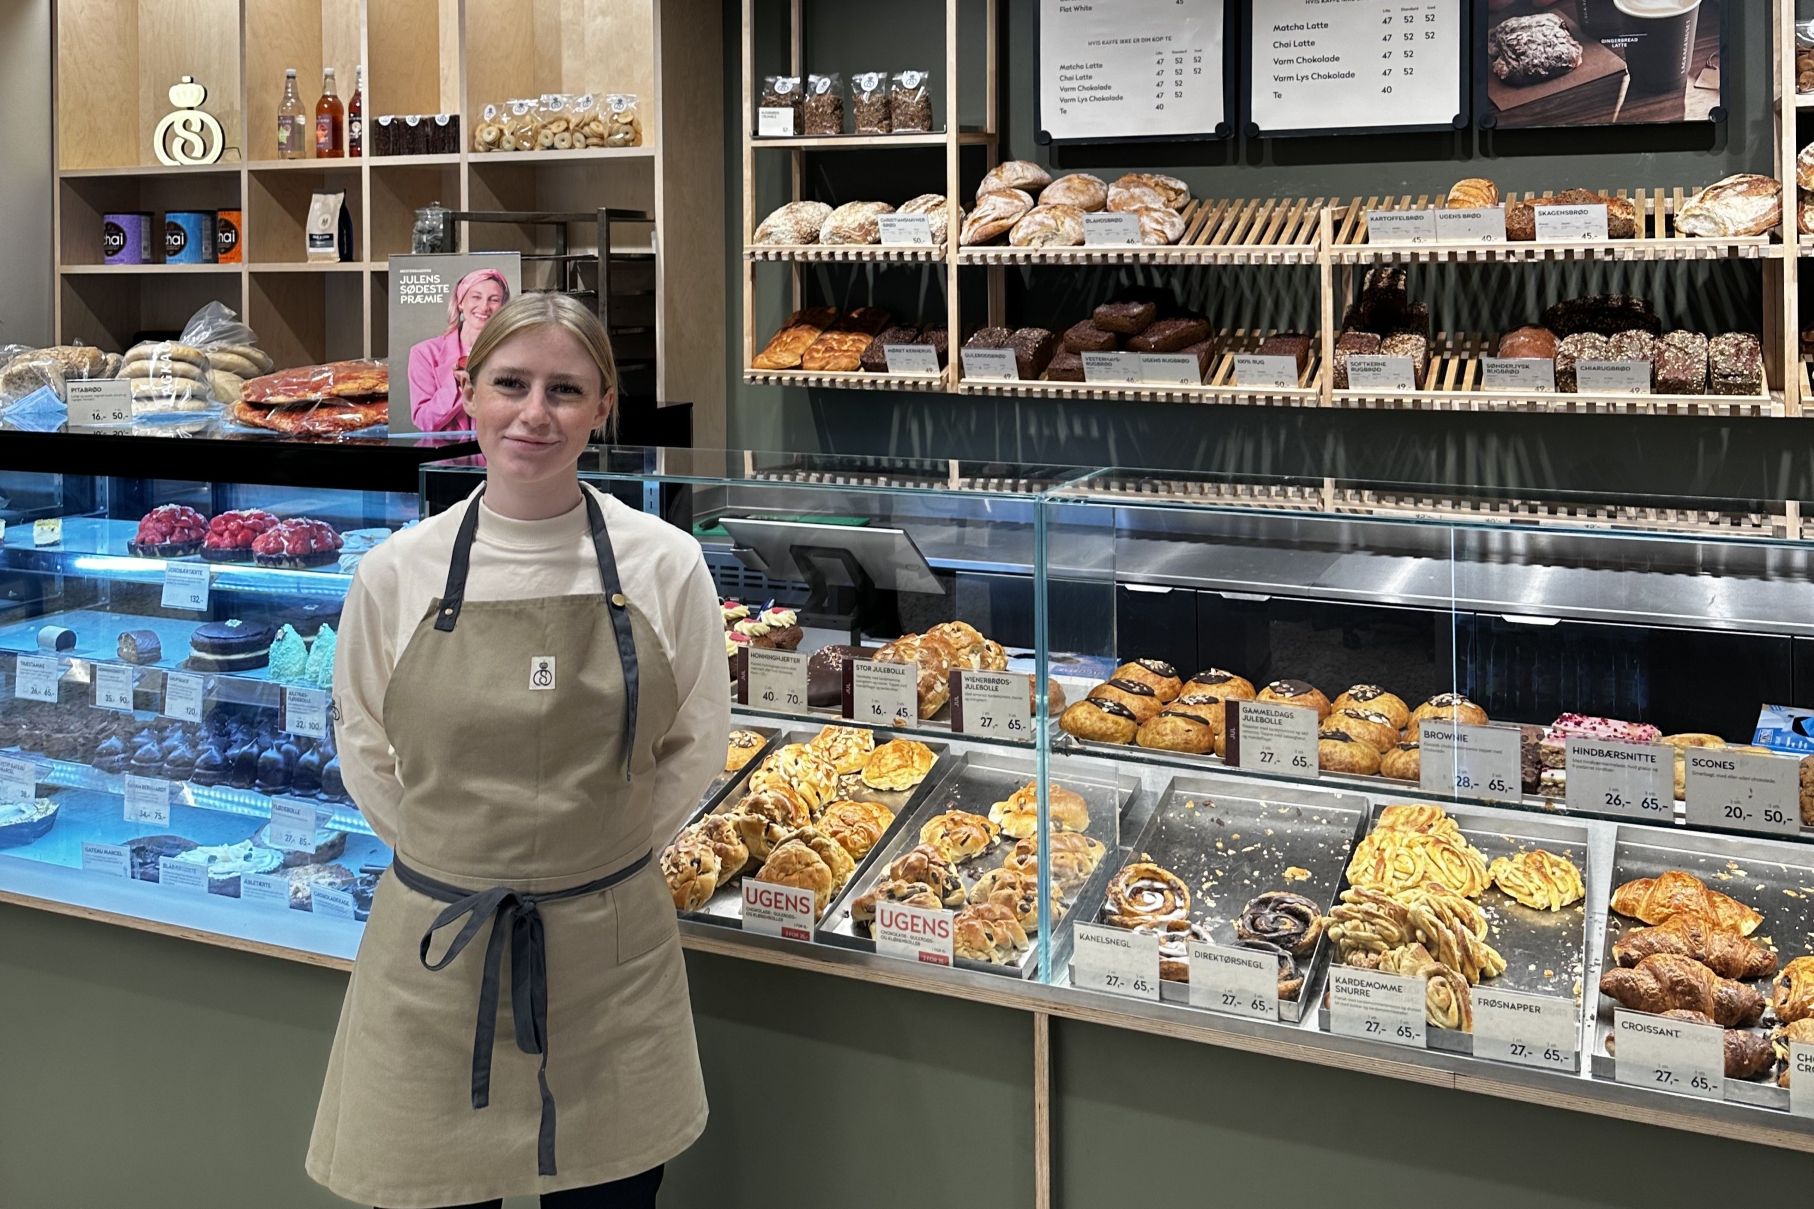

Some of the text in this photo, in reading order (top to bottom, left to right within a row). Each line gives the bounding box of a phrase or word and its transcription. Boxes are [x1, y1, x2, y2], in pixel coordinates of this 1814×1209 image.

[1273, 14, 1436, 32] Matcha Latte 47 52 52
[1273, 32, 1436, 48] Chai Latte 47 52 52
[1273, 50, 1414, 66] Varm Chokolade 47 52
[1273, 68, 1414, 82] Varm Lys Chokolade 47 52
[1382, 86, 1392, 94] 40
[400, 275, 440, 284] JULENS
[400, 284, 450, 294] SØDESTE
[400, 294, 444, 304] PRÆMIE
[750, 652, 800, 663] HONNINGHJERTER
[873, 667, 906, 675] JULEBOLLE
[964, 676, 1012, 686] WIENERBRØDS-
[762, 692, 803, 706] 40,- 70,-
[872, 704, 913, 719] 16,- 45,-
[1242, 706, 1294, 719] GAMMELDAGS
[981, 716, 1026, 731] 27,- 65,-
[1242, 715, 1282, 725] JULEBOLLE
[1424, 730, 1468, 742] BROWNIE
[1260, 752, 1313, 768] 27,- 65,-
[1572, 746, 1656, 763] HINDBÆRSNITTE
[1692, 758, 1735, 770] SCONES
[1456, 776, 1514, 793] 28,- 65,-
[1605, 793, 1668, 812] 26,- 65,-
[1724, 806, 1793, 825] 20,- 50,-
[746, 886, 810, 914] UGENS
[880, 909, 950, 938] UGENS
[1080, 932, 1131, 948] KANELSNEGL
[1194, 950, 1264, 970] DIREKTØRSNEGL
[1106, 974, 1154, 993] 27,- 65,-
[1336, 976, 1403, 993] KARDEMOMME
[1336, 985, 1370, 998] SNURRE
[1222, 994, 1274, 1013] 27,- 65,-
[1478, 998, 1541, 1014] FRØSNAPPER
[1366, 1020, 1420, 1040] 27,- 65,-
[1622, 1020, 1680, 1038] CROISSANT
[1510, 1044, 1569, 1063] 27,- 65,-
[1797, 1053, 1814, 1063] CH
[1655, 1069, 1718, 1092] 27,- 65,-
